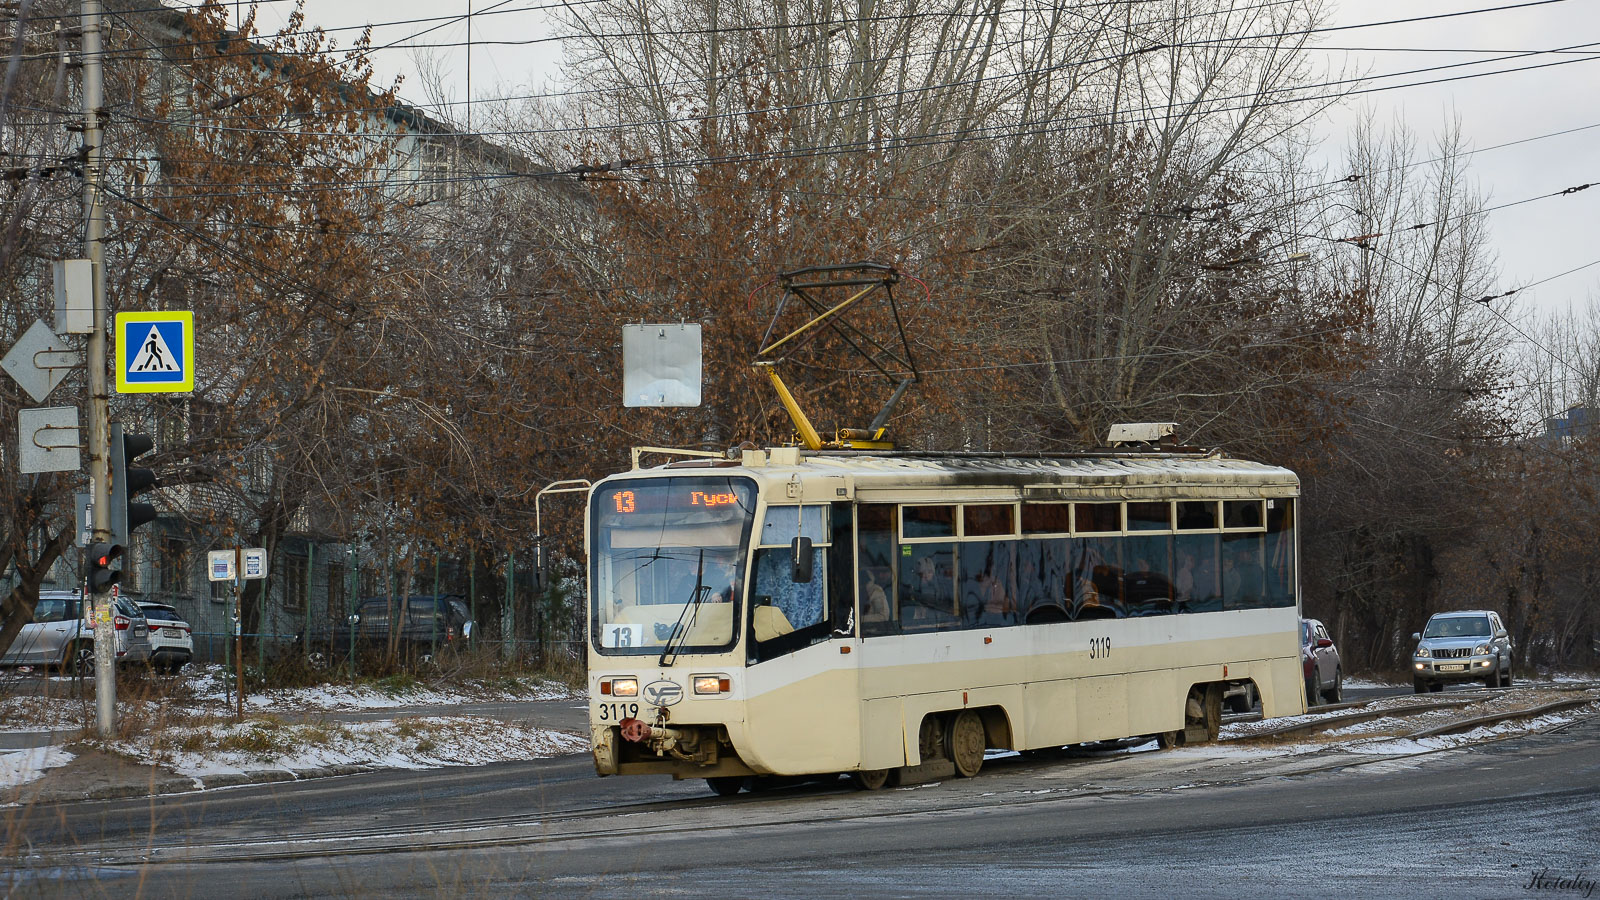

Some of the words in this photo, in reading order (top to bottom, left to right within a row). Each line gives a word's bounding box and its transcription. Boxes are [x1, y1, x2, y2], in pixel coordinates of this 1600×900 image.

[612, 490, 635, 513] 13
[612, 627, 632, 648] 13
[1089, 636, 1111, 659] 3119
[599, 703, 639, 721] 3119
